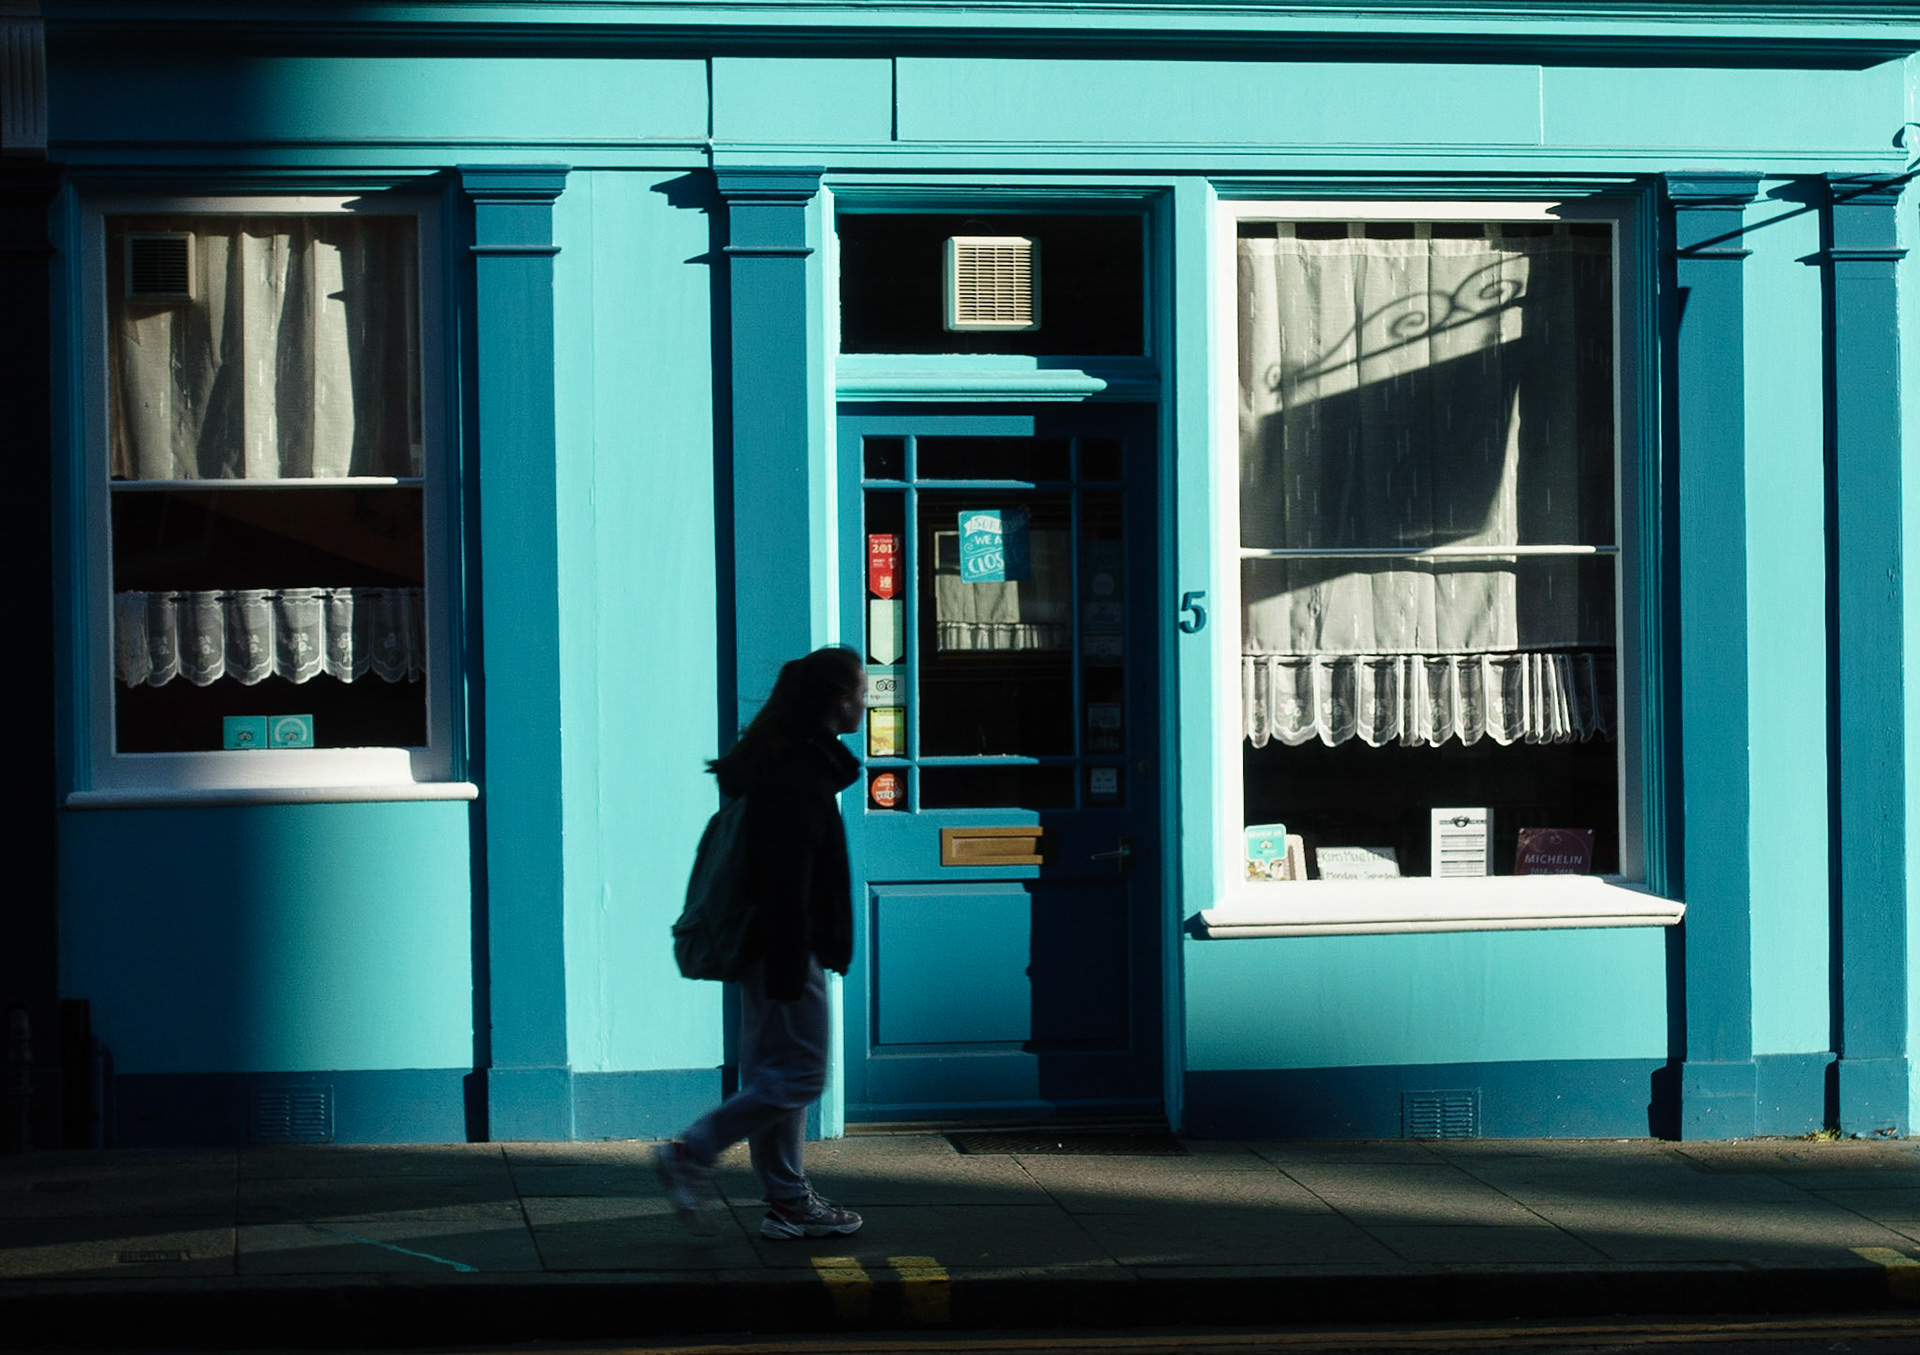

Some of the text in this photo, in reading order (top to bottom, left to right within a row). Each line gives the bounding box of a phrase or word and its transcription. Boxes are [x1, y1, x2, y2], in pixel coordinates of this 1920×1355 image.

[974, 534, 992, 545] WE
[1179, 591, 1206, 633] 5
[1524, 854, 1584, 865] MICHELIN
